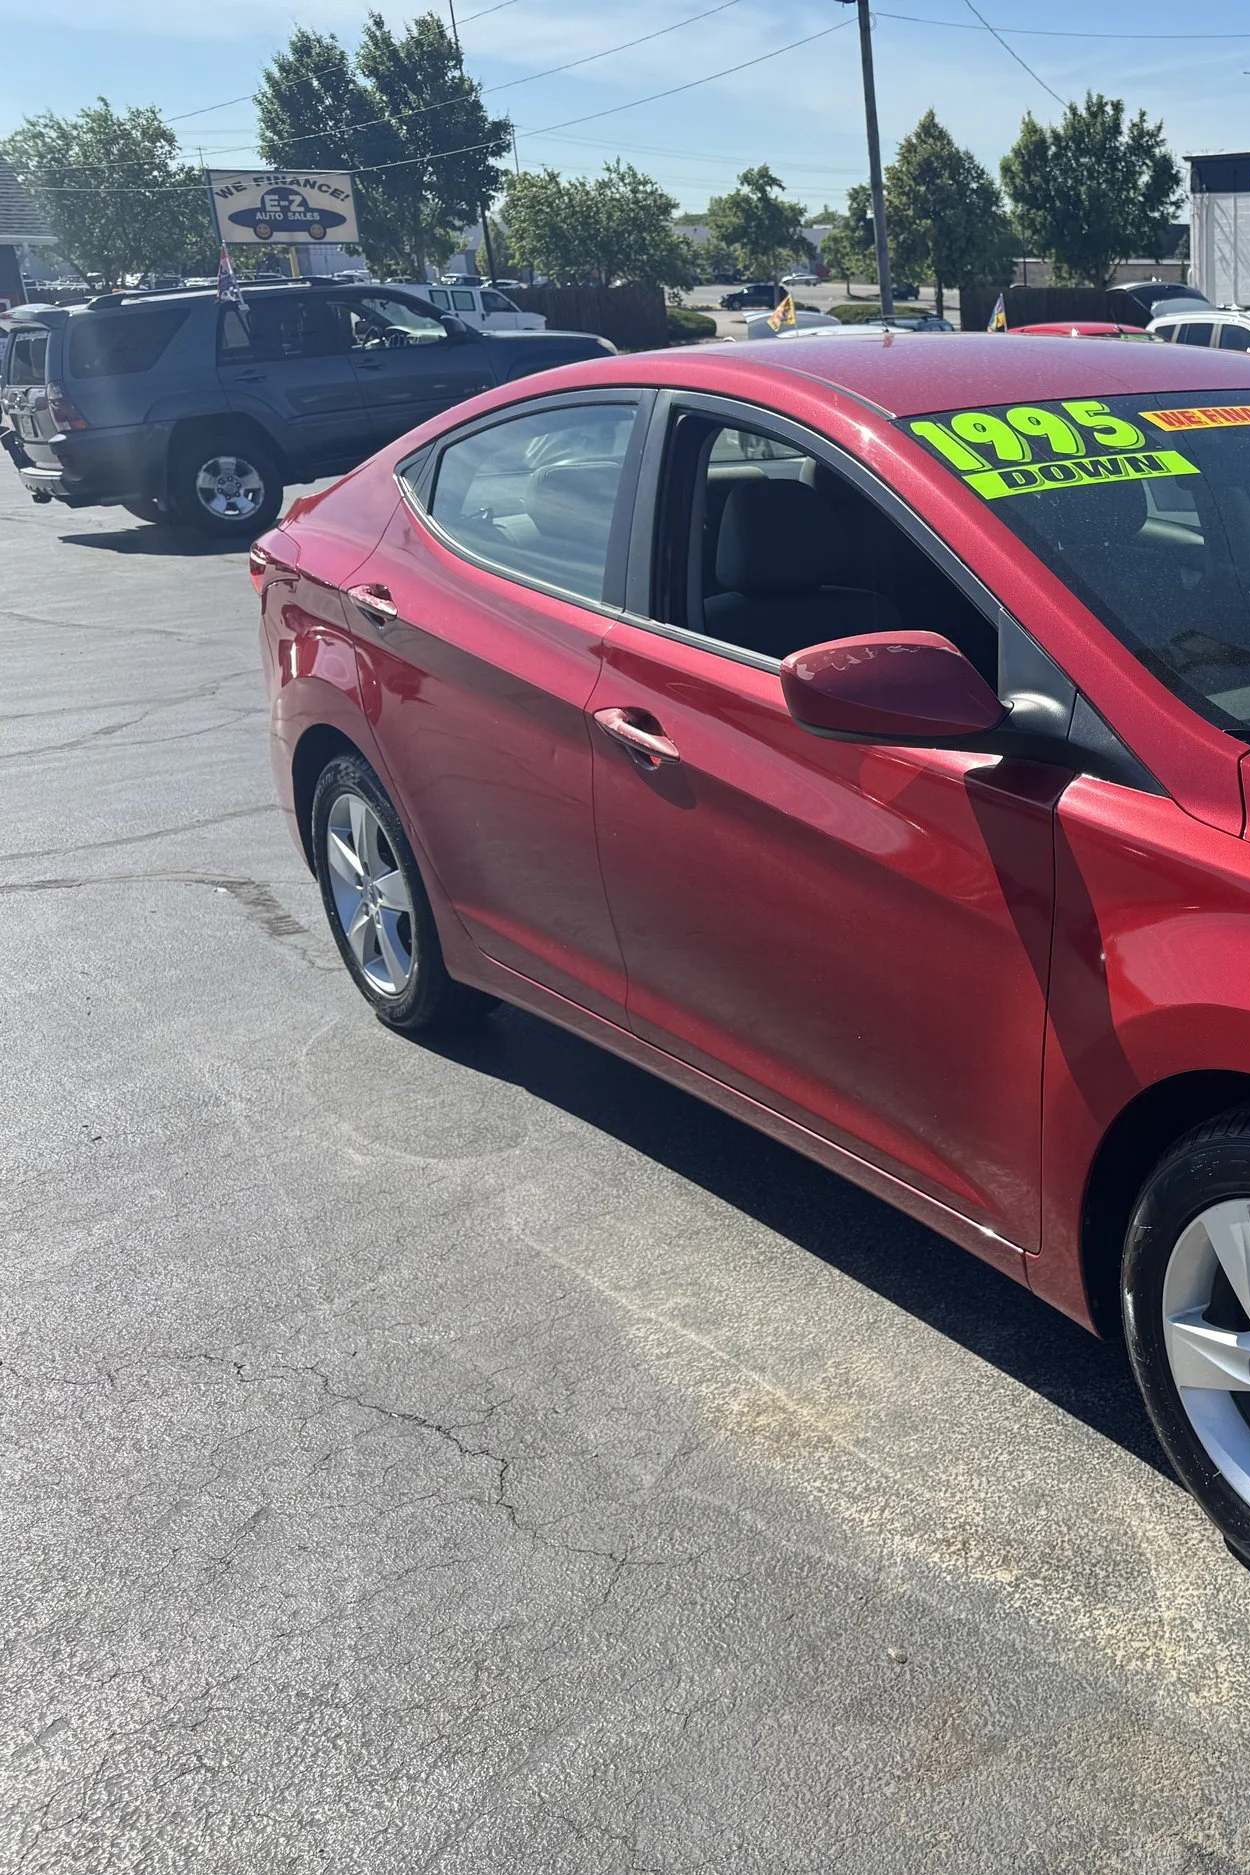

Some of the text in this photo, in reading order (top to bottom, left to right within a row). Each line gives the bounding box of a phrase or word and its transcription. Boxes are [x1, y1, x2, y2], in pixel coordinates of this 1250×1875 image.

[215, 175, 350, 202] WE FINANCE!
[263, 195, 305, 212] E-Z
[256, 212, 320, 221] AUTO SALES
[1152, 409, 1204, 428] WE
[910, 401, 1146, 472] 1995
[998, 453, 1172, 491] DOWN
